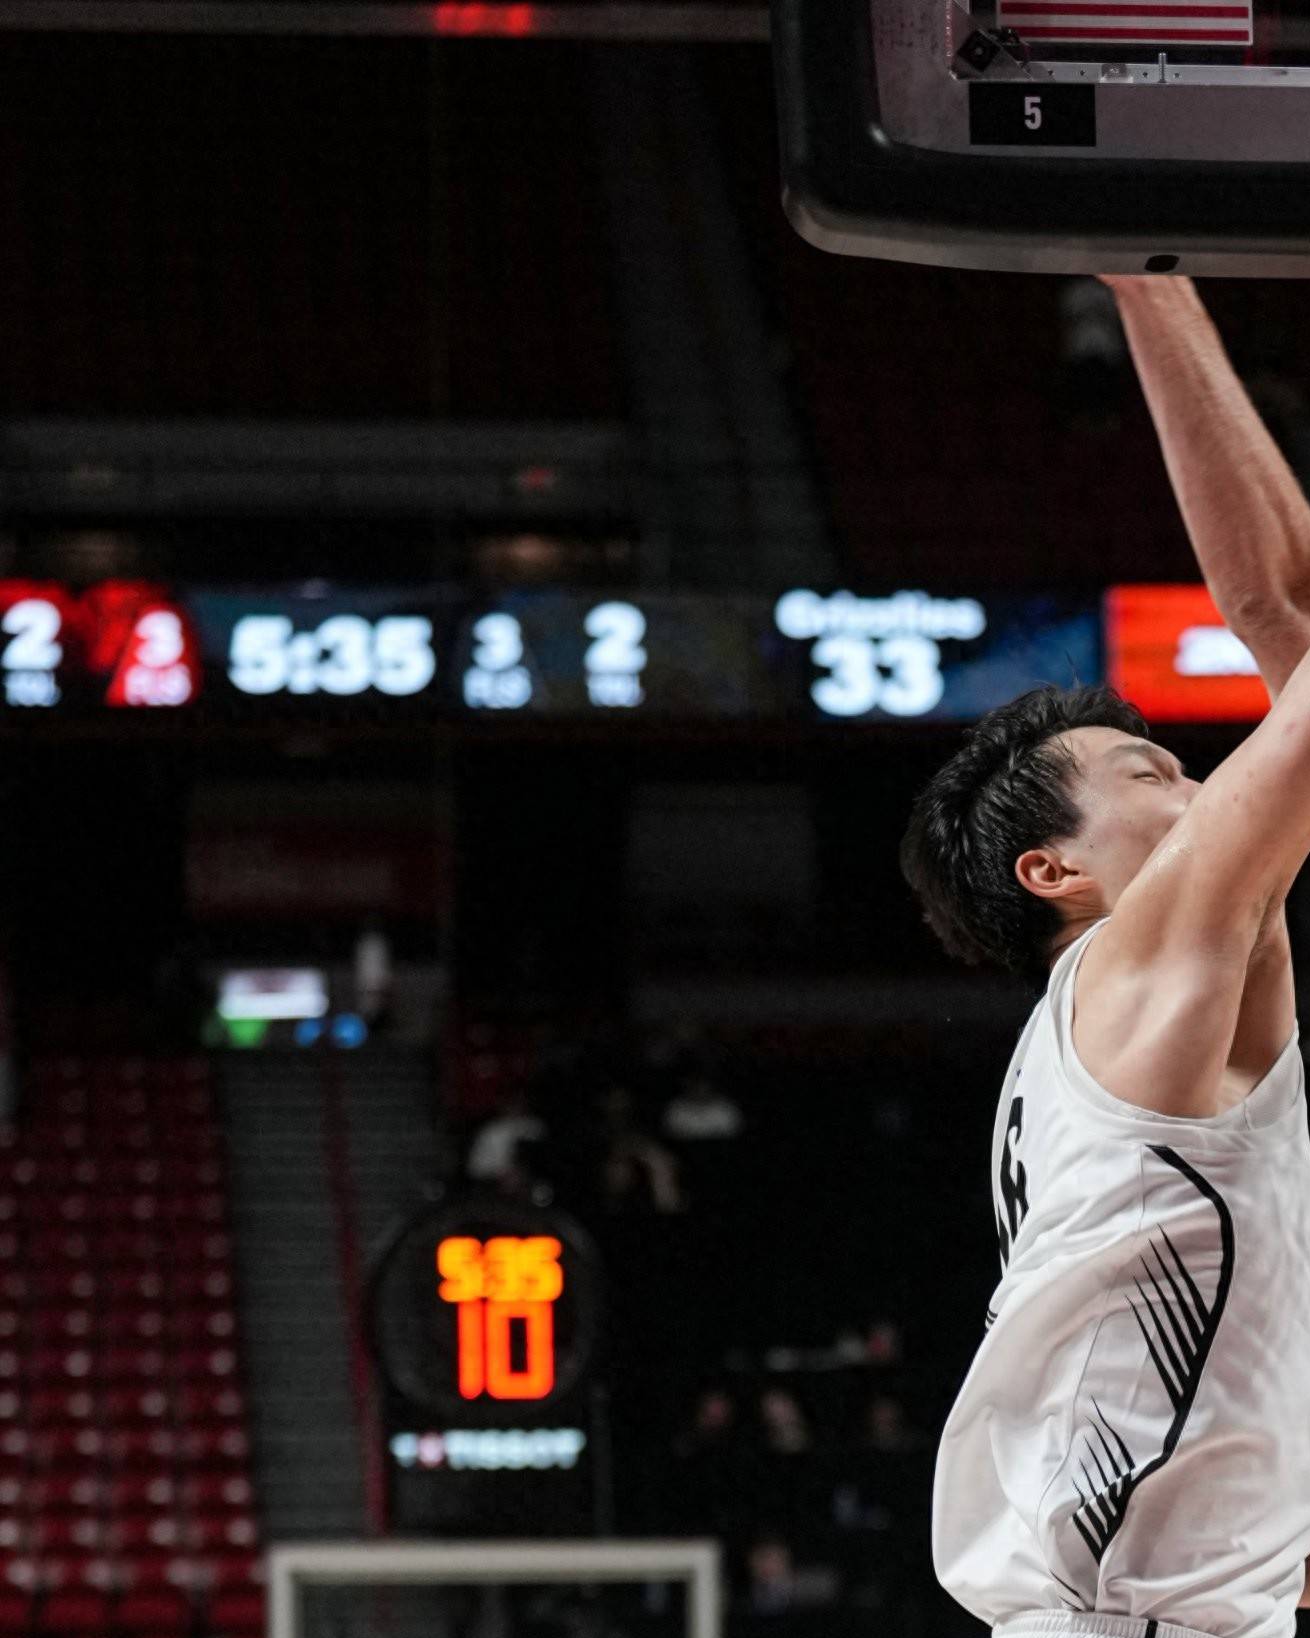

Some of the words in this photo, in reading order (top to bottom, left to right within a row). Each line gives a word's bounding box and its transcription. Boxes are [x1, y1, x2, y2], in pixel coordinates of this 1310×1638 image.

[1024, 96, 1042, 130] 5
[2, 599, 62, 670] 2
[228, 614, 435, 695] 5:35
[585, 602, 647, 673] 2
[811, 636, 943, 716] 33
[457, 1299, 554, 1400] 10
